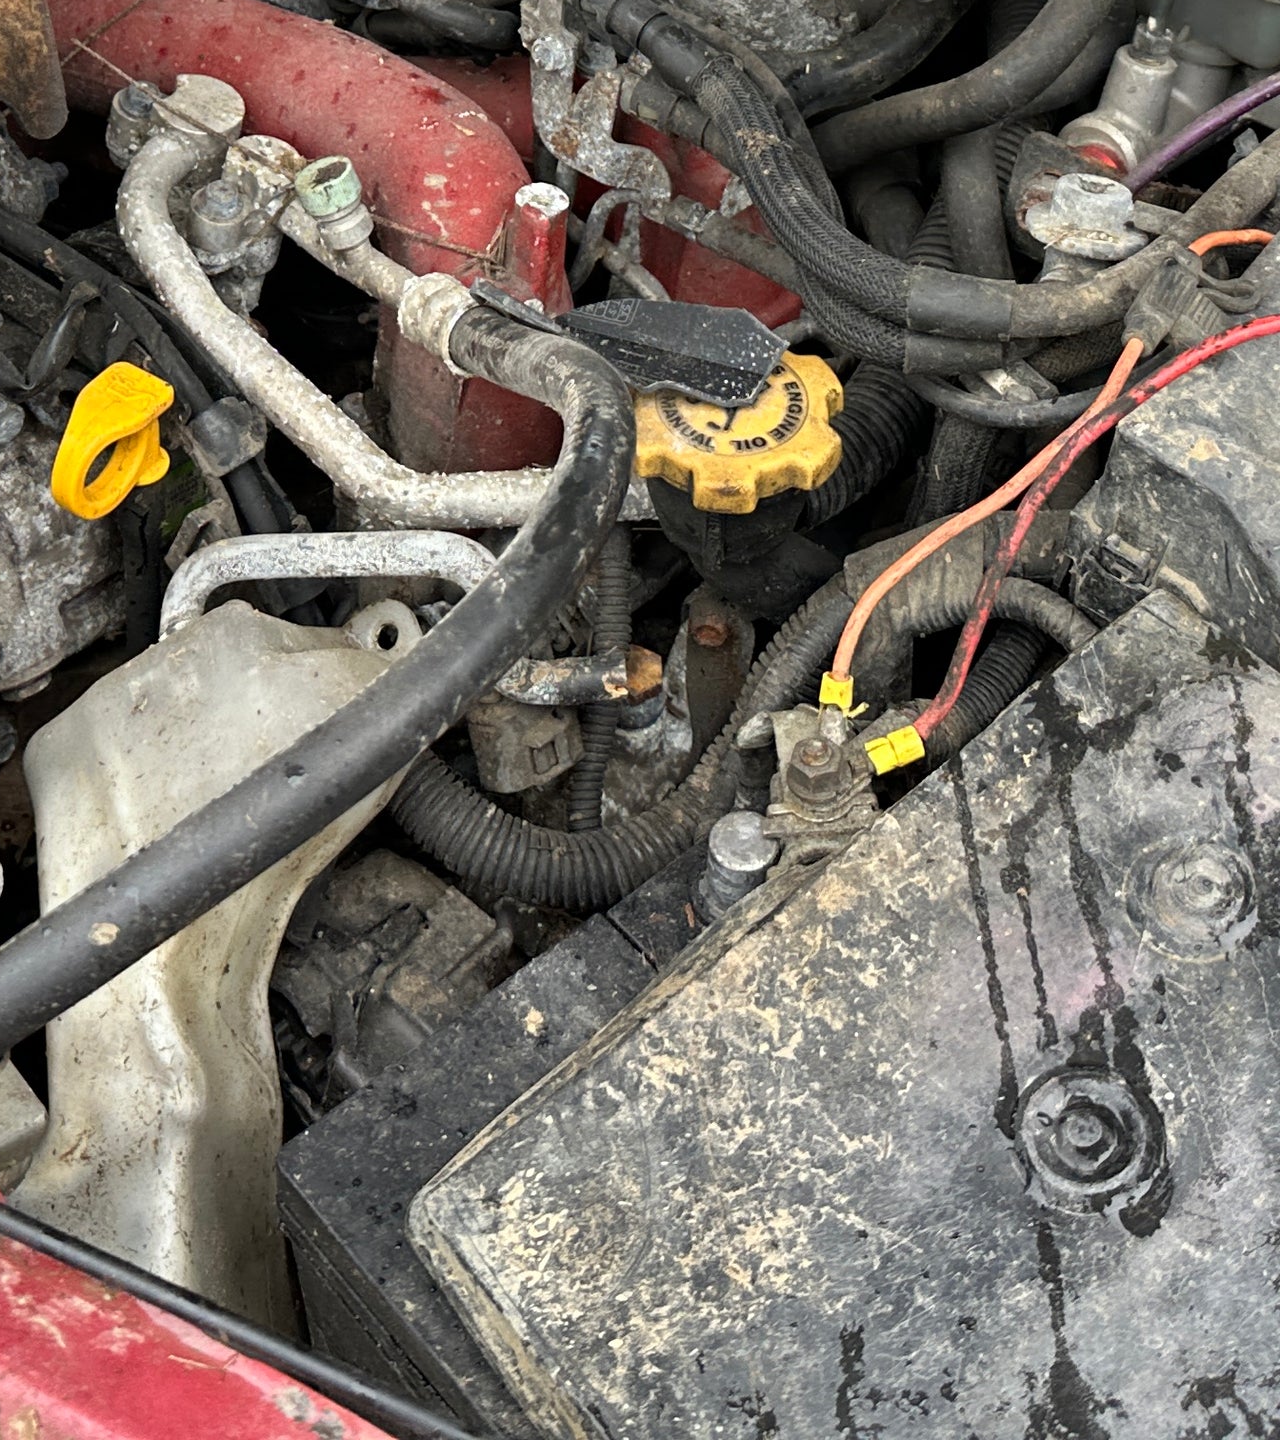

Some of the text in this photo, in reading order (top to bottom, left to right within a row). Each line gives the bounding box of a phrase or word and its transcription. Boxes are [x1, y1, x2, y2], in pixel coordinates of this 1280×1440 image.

[662, 395, 716, 453] MANUAL
[732, 381, 801, 452] ENGINE OIL
